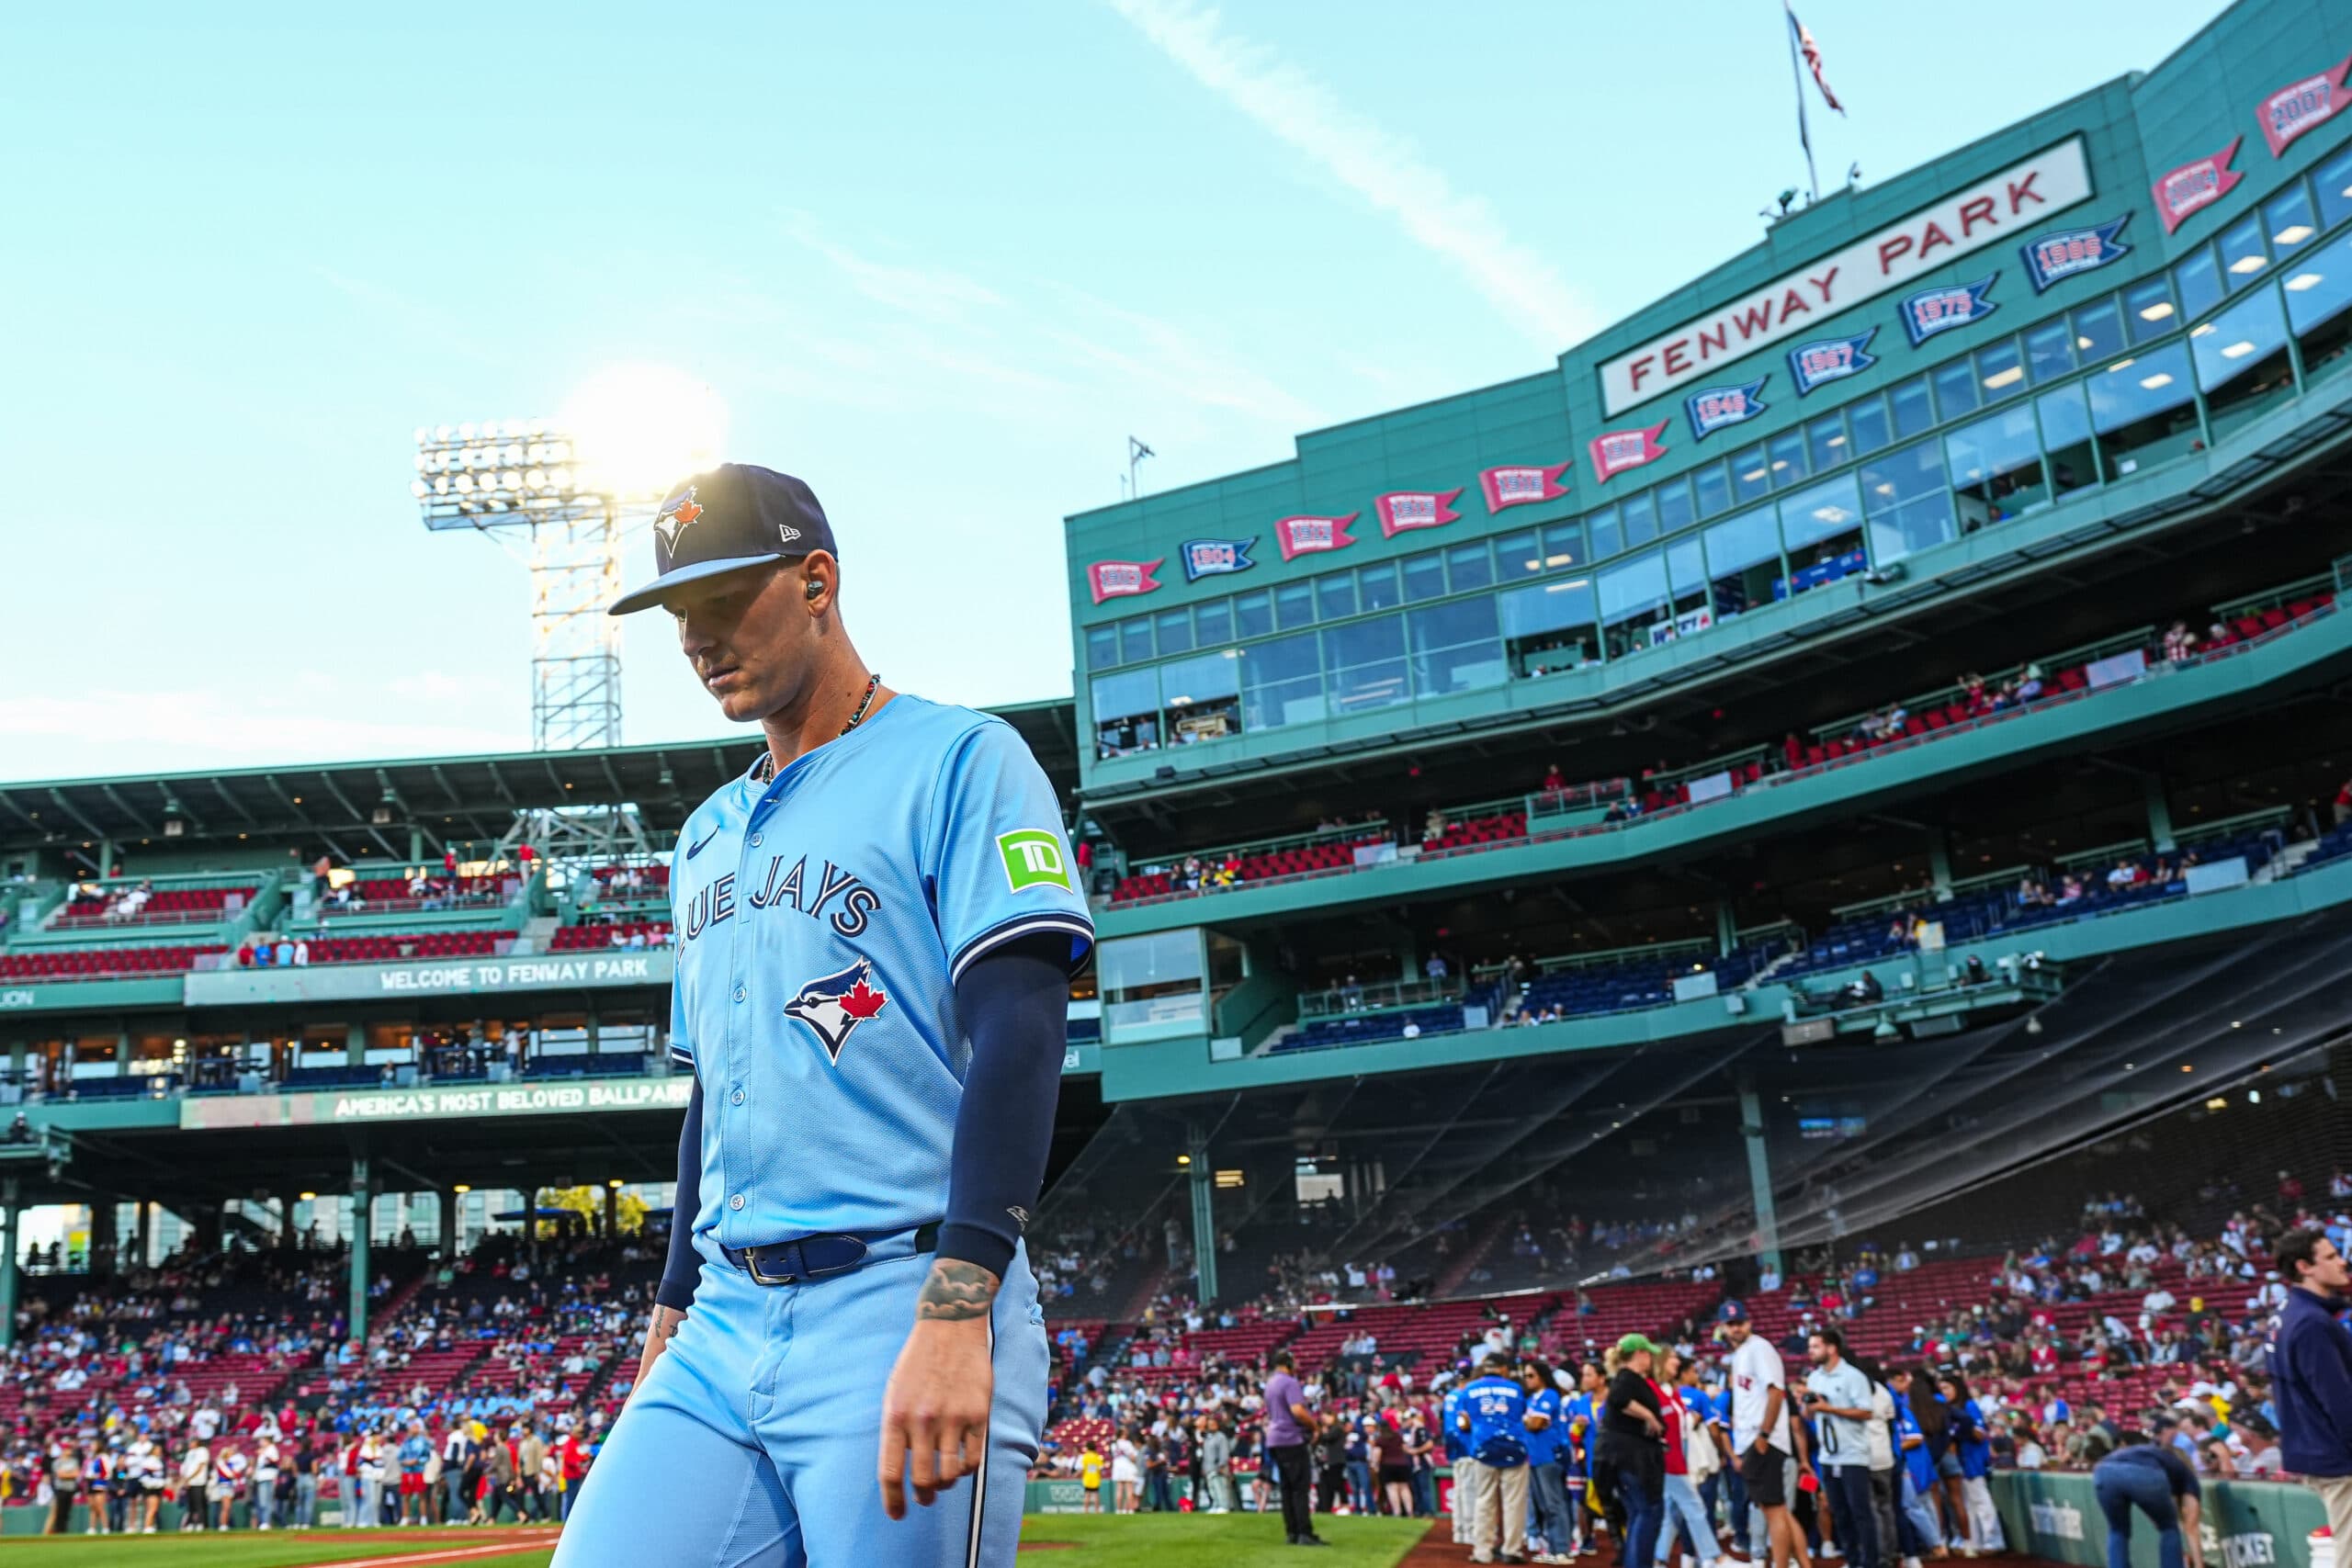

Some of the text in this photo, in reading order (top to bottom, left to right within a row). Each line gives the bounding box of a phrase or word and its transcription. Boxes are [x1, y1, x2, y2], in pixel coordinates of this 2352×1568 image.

[2270, 84, 2332, 130] 2007
[2039, 236, 2101, 270] 1986
[1629, 171, 2046, 391] FENWAY PARK
[1916, 294, 1973, 323] 1975
[1802, 345, 1853, 375] 1967
[1193, 547, 1235, 566] 1904
[1009, 840, 1063, 874] TD
[749, 854, 880, 938] JAYS
[380, 959, 648, 989] WELCOME TO FENWAY PARK
[335, 1084, 691, 1117] AMERICA'S MOST BELOVED BALLPARK
[1480, 1396, 1510, 1416] 24
